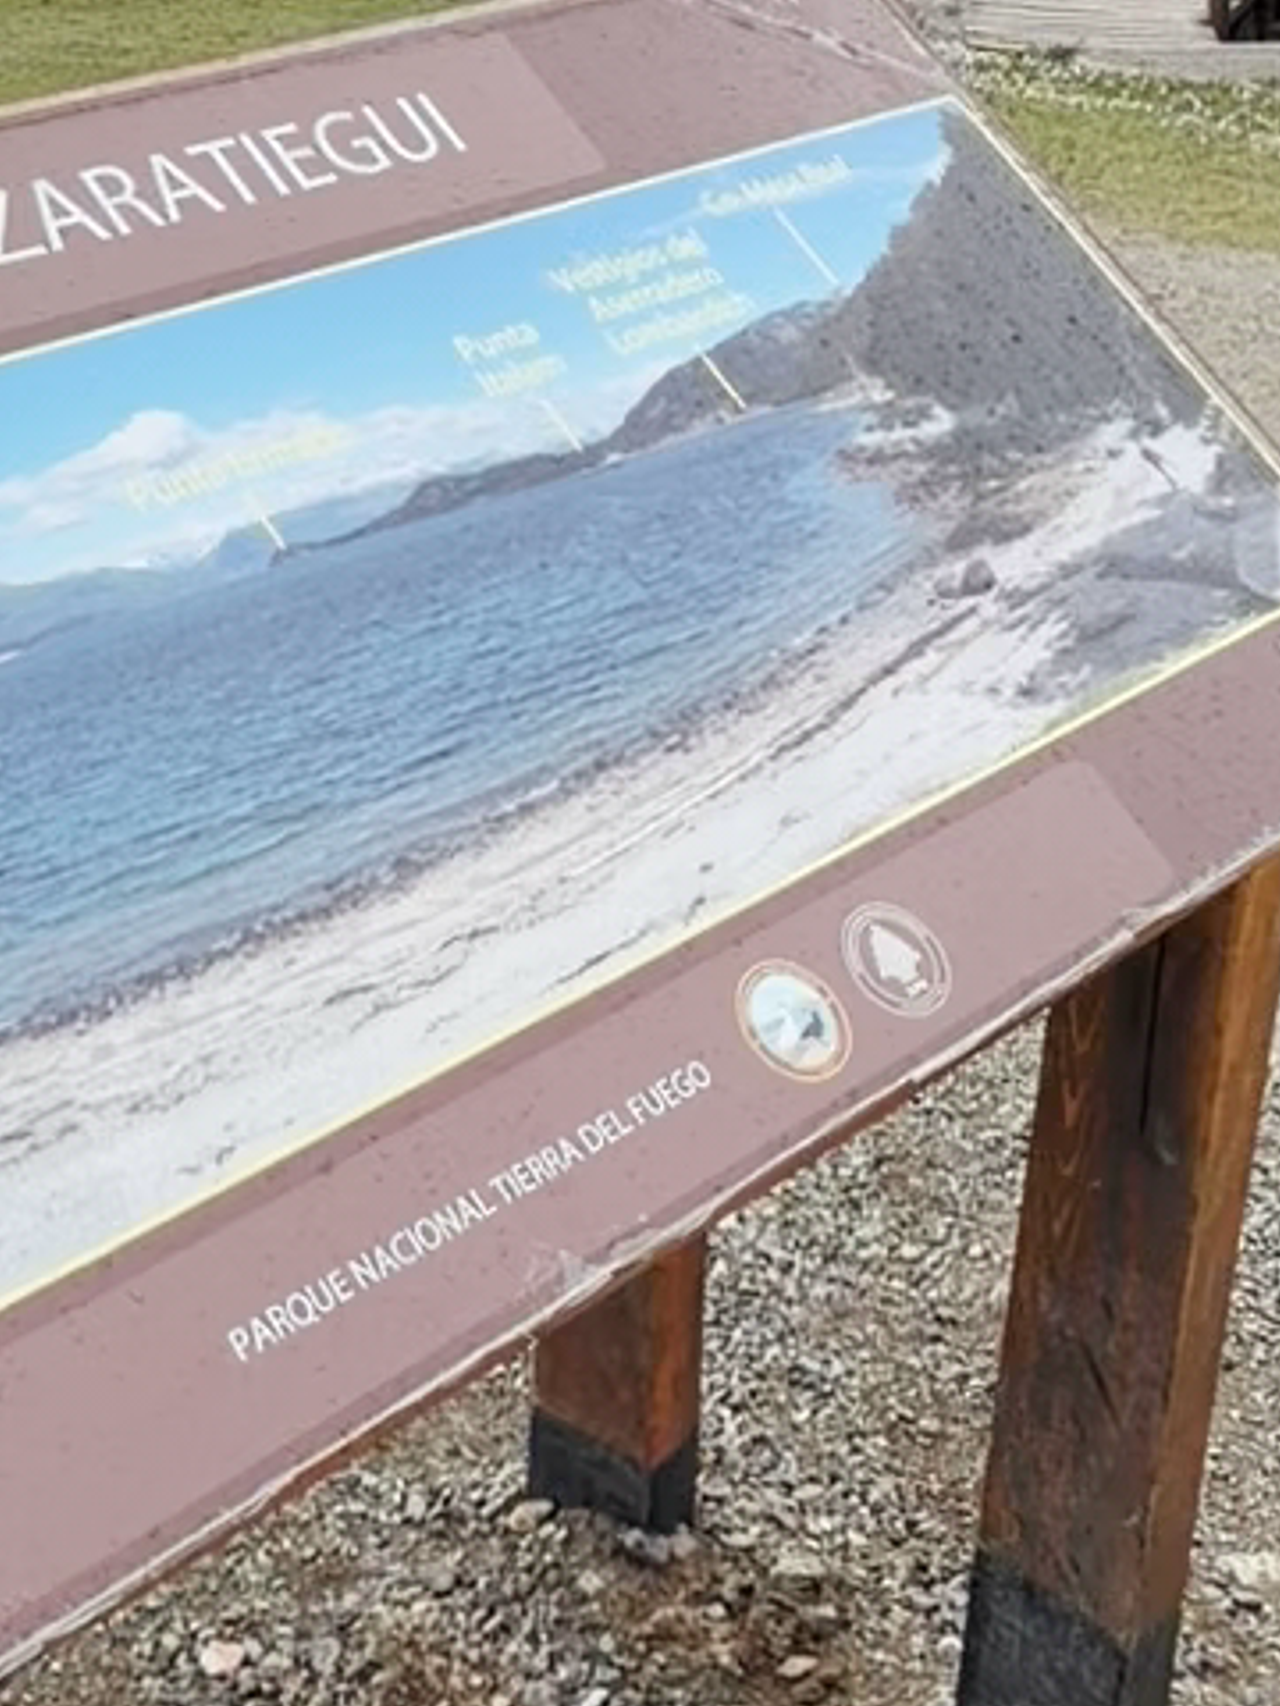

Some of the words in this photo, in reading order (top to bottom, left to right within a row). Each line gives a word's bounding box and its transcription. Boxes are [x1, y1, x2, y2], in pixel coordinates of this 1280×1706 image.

[453, 322, 541, 364] Punta
[226, 1268, 356, 1363] PARQUE
[348, 1188, 498, 1290] NACIONAL
[488, 1136, 585, 1204] TIERRA
[576, 1108, 634, 1155] DEL
[626, 1060, 712, 1125] FUEGO
